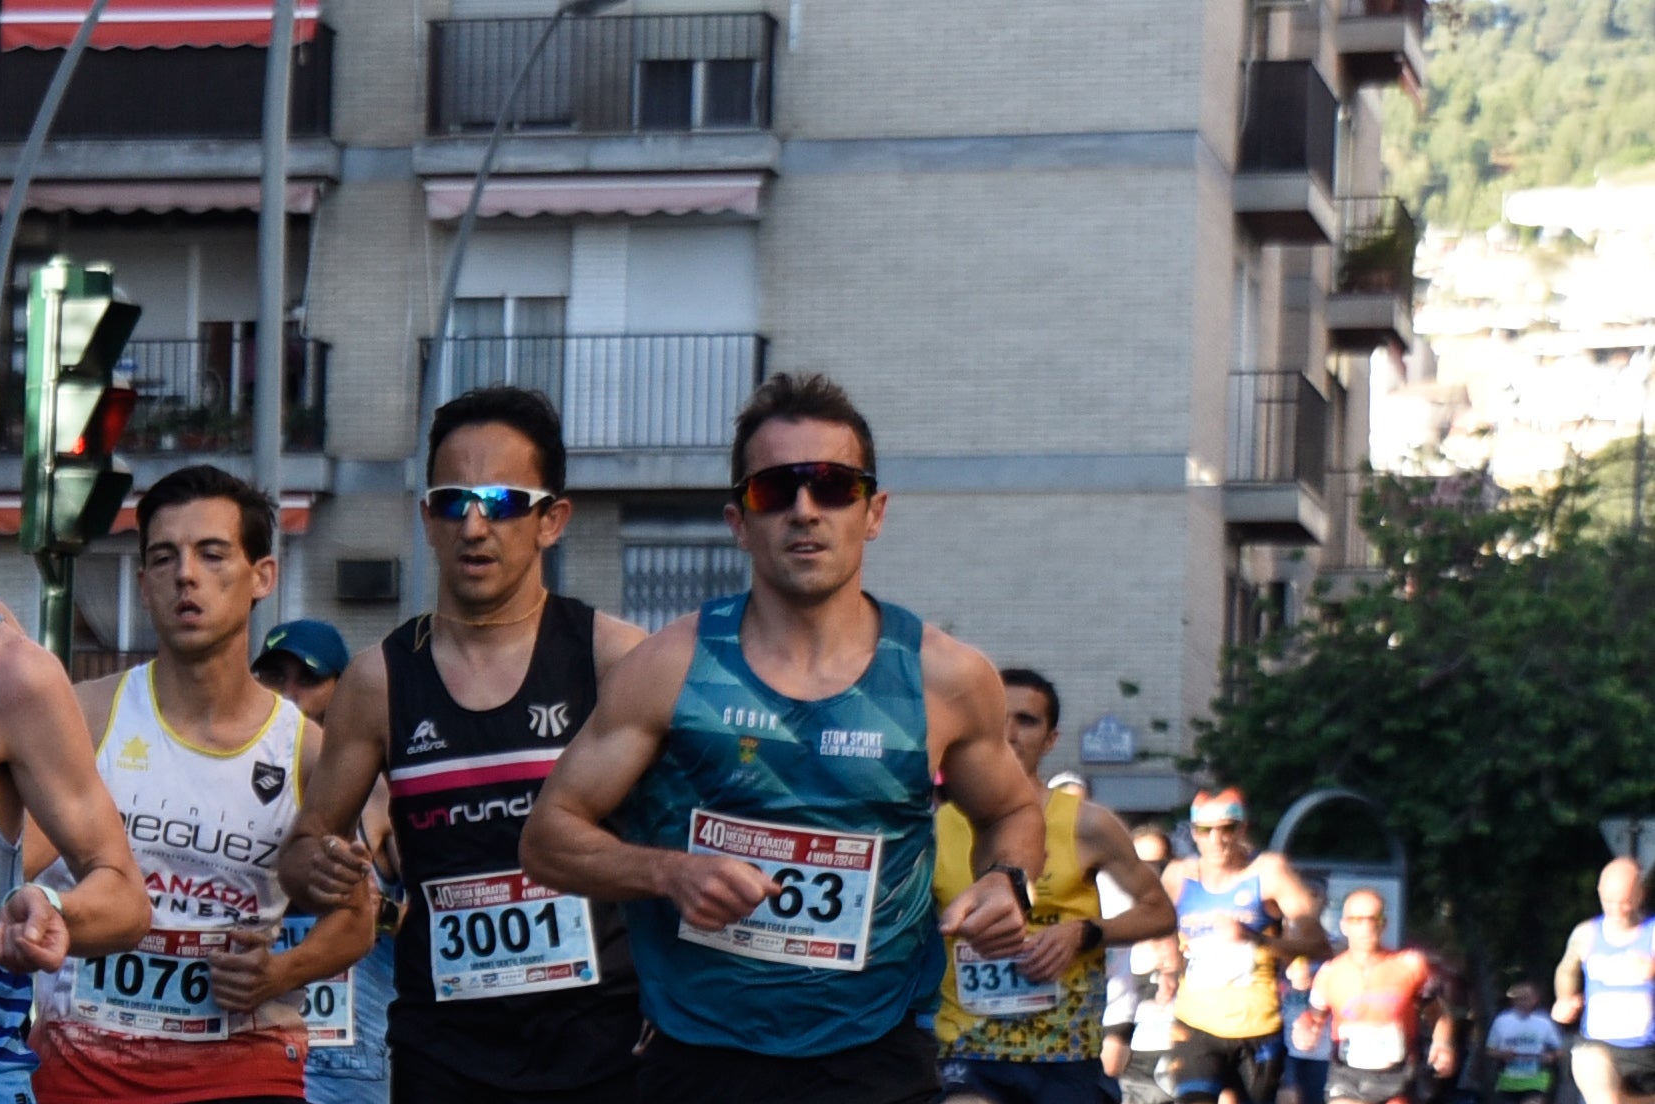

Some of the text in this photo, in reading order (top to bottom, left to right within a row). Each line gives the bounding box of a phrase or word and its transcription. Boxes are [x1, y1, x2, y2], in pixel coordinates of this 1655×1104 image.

[723, 707, 778, 730] GOBIK
[849, 731, 883, 746] SPORT
[698, 819, 725, 848] 40
[805, 850, 853, 866] 4 MAYO 2024
[145, 871, 259, 914] ANADA
[435, 885, 455, 909] 40
[767, 867, 844, 923] 63
[149, 895, 260, 926] NNERS
[439, 902, 561, 961] 3001
[84, 953, 209, 1005] 1076
[961, 962, 1020, 992] 331
